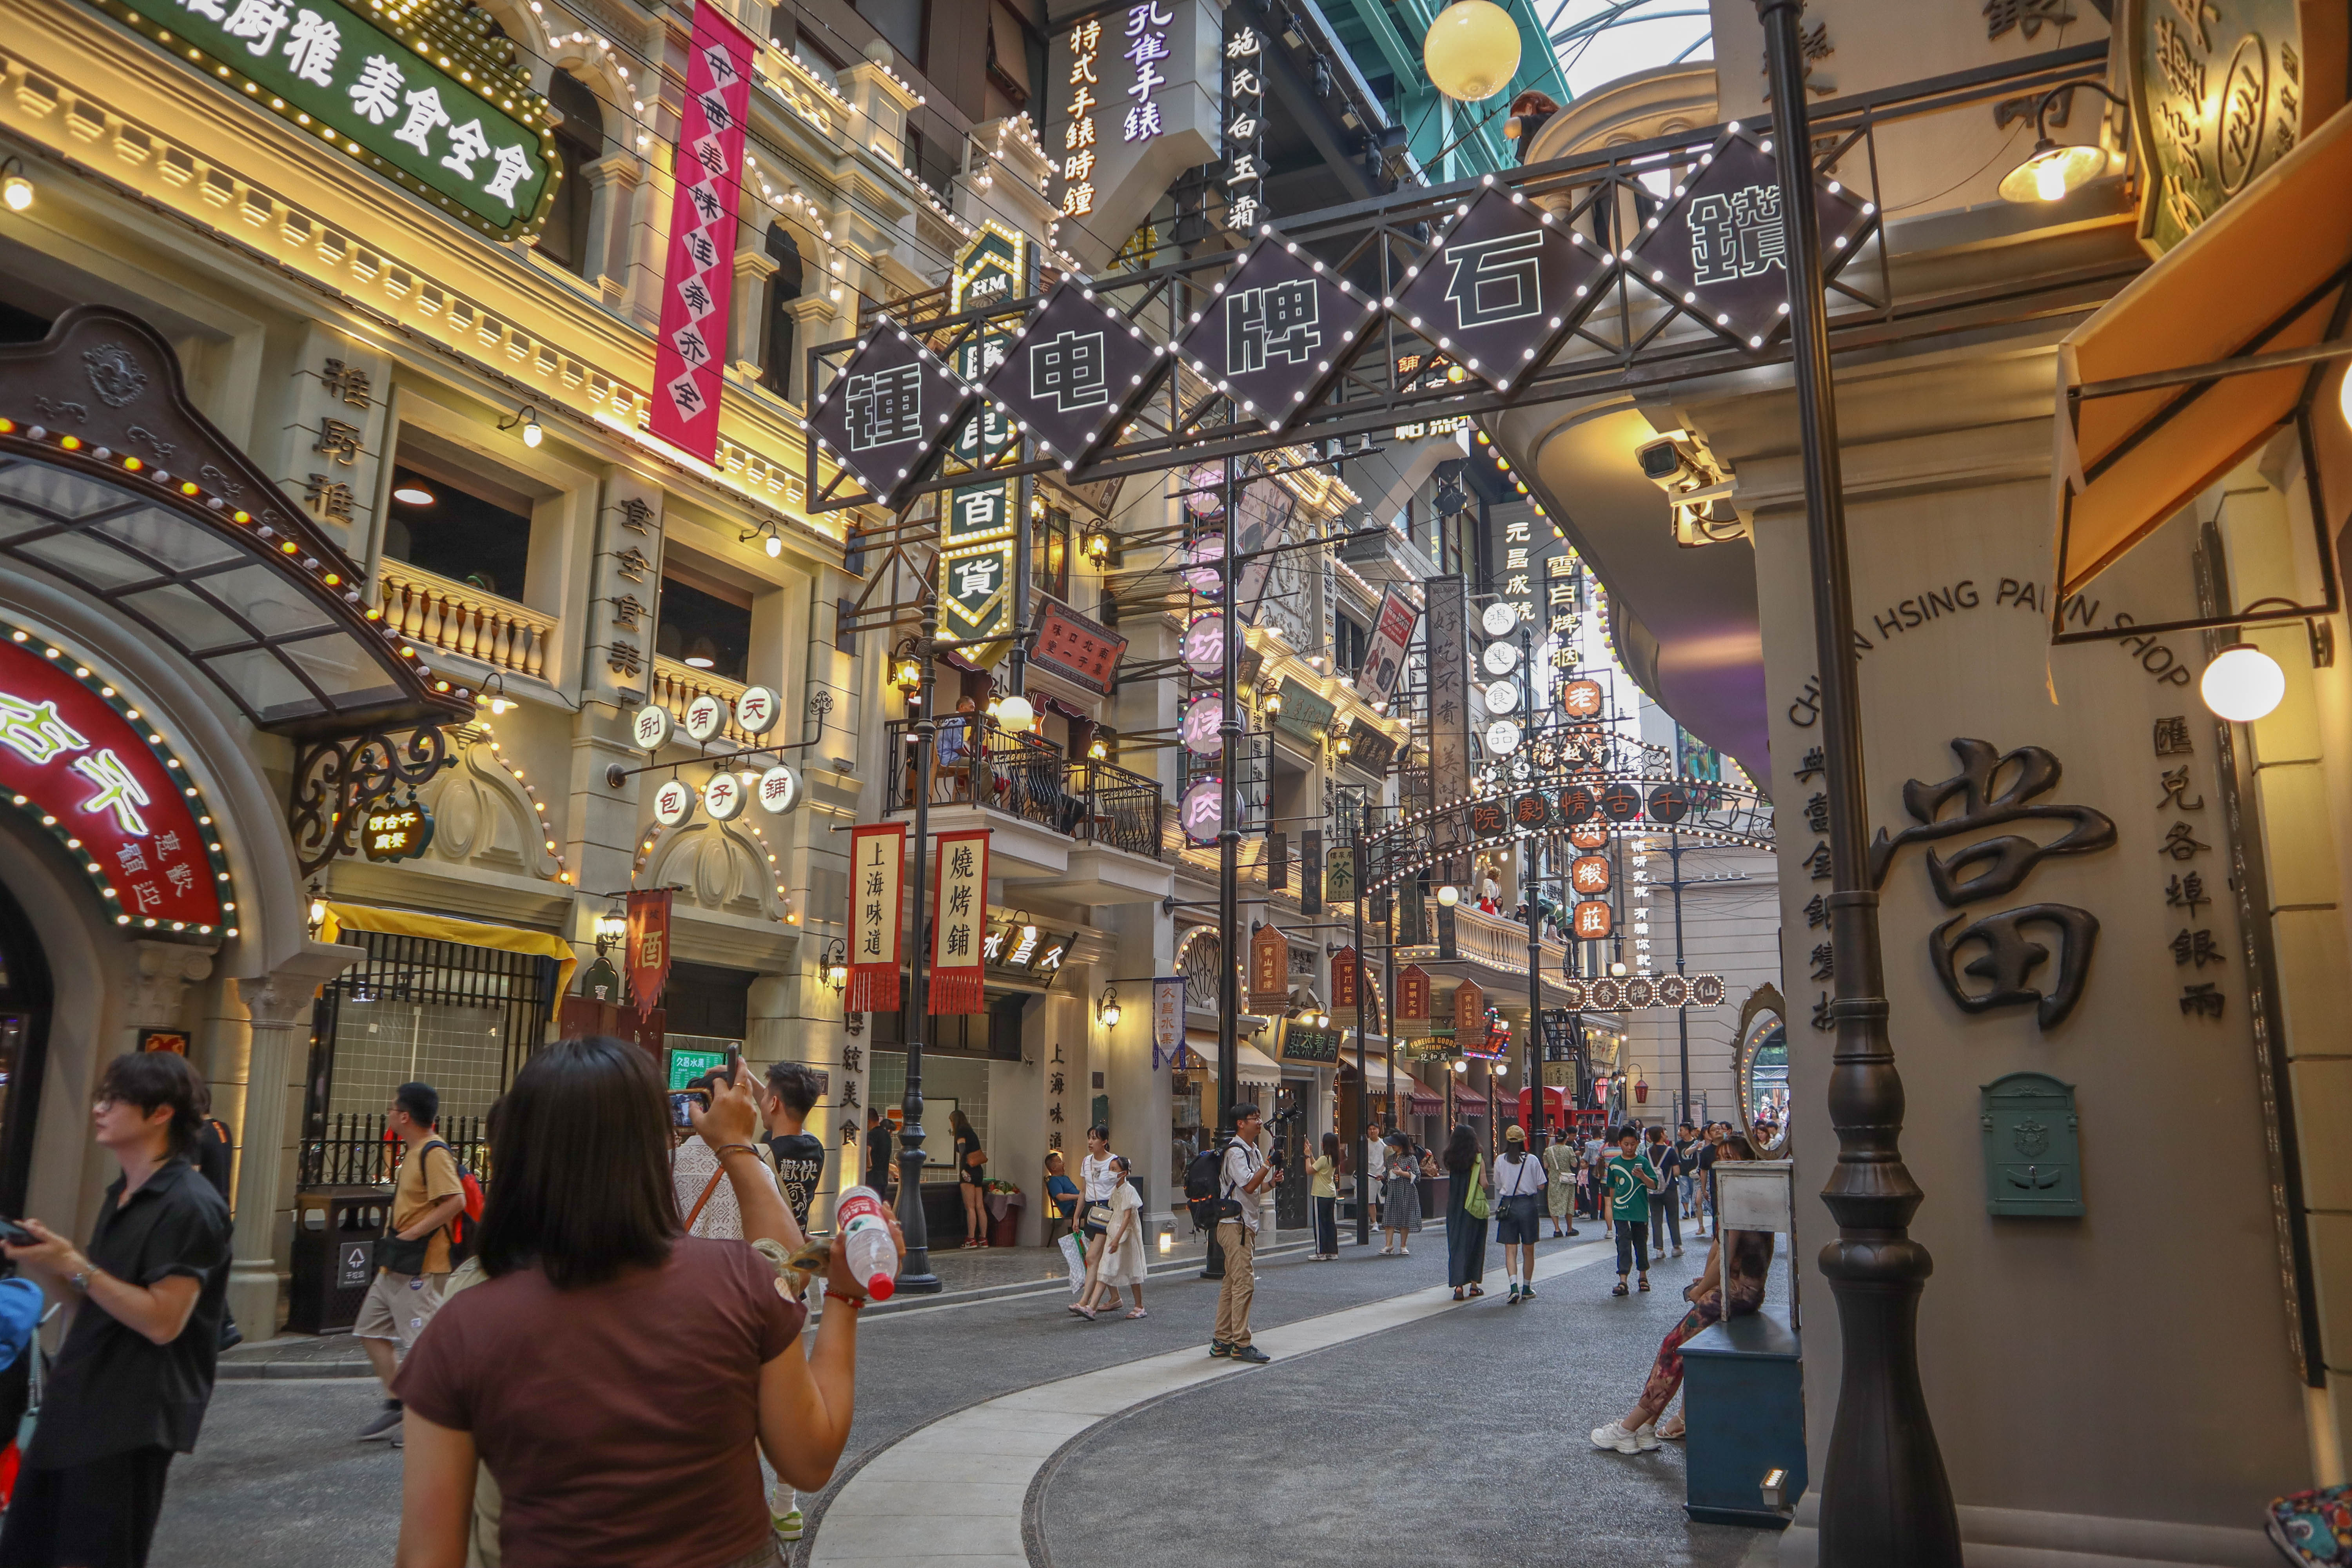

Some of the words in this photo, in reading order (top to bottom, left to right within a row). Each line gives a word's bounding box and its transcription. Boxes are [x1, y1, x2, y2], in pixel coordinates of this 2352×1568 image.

[1227, 26, 1261, 230] 施氏白玉霜
[972, 273, 1007, 297] HM
[607, 497, 655, 678] 食全食美
[1874, 579, 1980, 639] HSING
[1487, 608, 1513, 744] 鴻運食品
[660, 777, 788, 815] 包子鋪
[1474, 788, 1683, 831] 千古情劇院
[864, 842, 885, 955] 上海味道
[946, 845, 974, 957] 燒烤鋪
[1330, 861, 1354, 888] 茶
[1871, 737, 2119, 1031] 當
[635, 930, 663, 969] 酒
[1160, 986, 1176, 1045] 久昌水果
[1410, 1037, 1435, 1049] FOREIGN
[1437, 1037, 1457, 1048] GOODS
[677, 1056, 704, 1068] 久昌水果
[1049, 1043, 1065, 1149] 上海味道
[778, 1158, 818, 1183] 歡快
